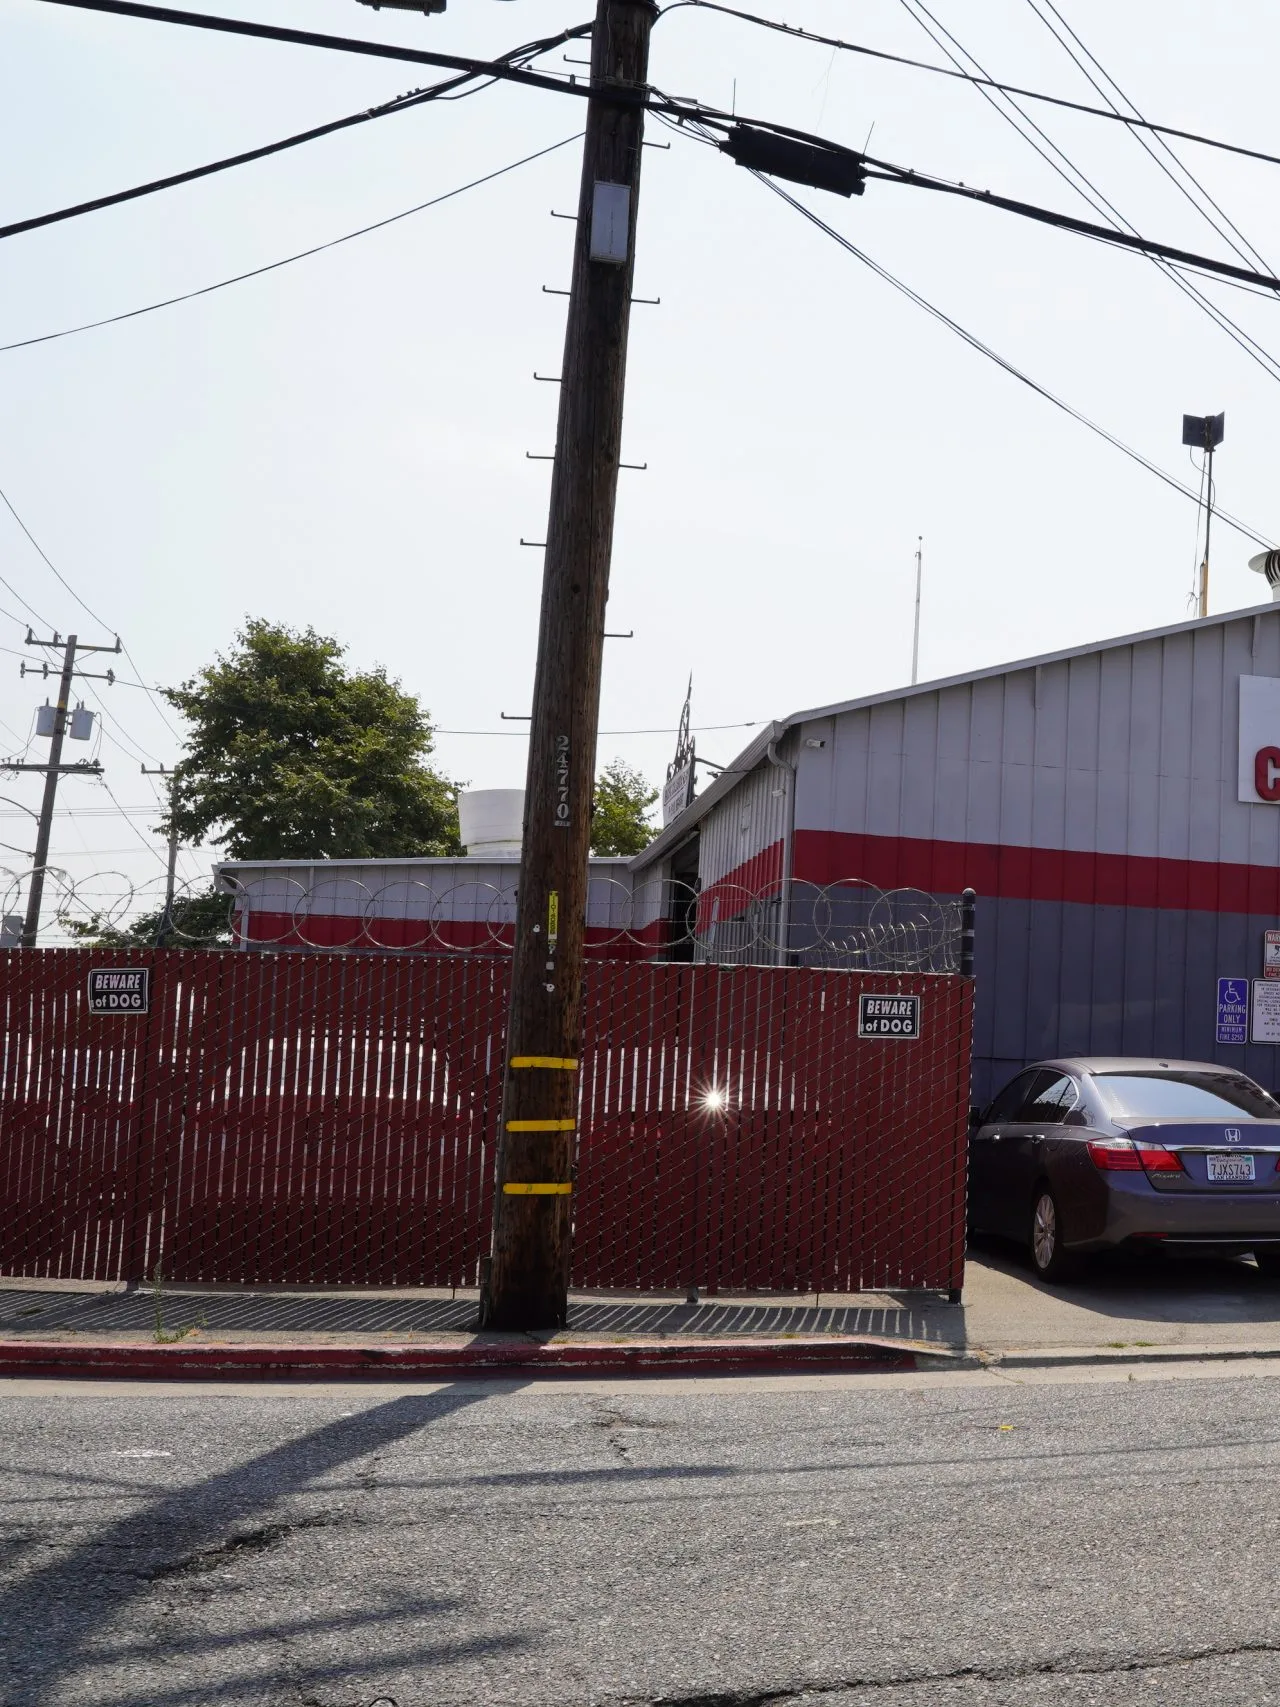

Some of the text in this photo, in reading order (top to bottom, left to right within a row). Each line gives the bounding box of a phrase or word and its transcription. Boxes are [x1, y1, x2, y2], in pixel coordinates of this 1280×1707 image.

[556, 735, 570, 819] 24770
[95, 974, 141, 989] BEWARE
[95, 994, 141, 1008] of DOG
[866, 1000, 913, 1015] BEWARE
[1218, 1003, 1246, 1014] PARKING
[865, 1019, 913, 1033] of DOG
[1223, 1014, 1241, 1024] ONLY
[1211, 1164, 1251, 1176] 7JXS743
